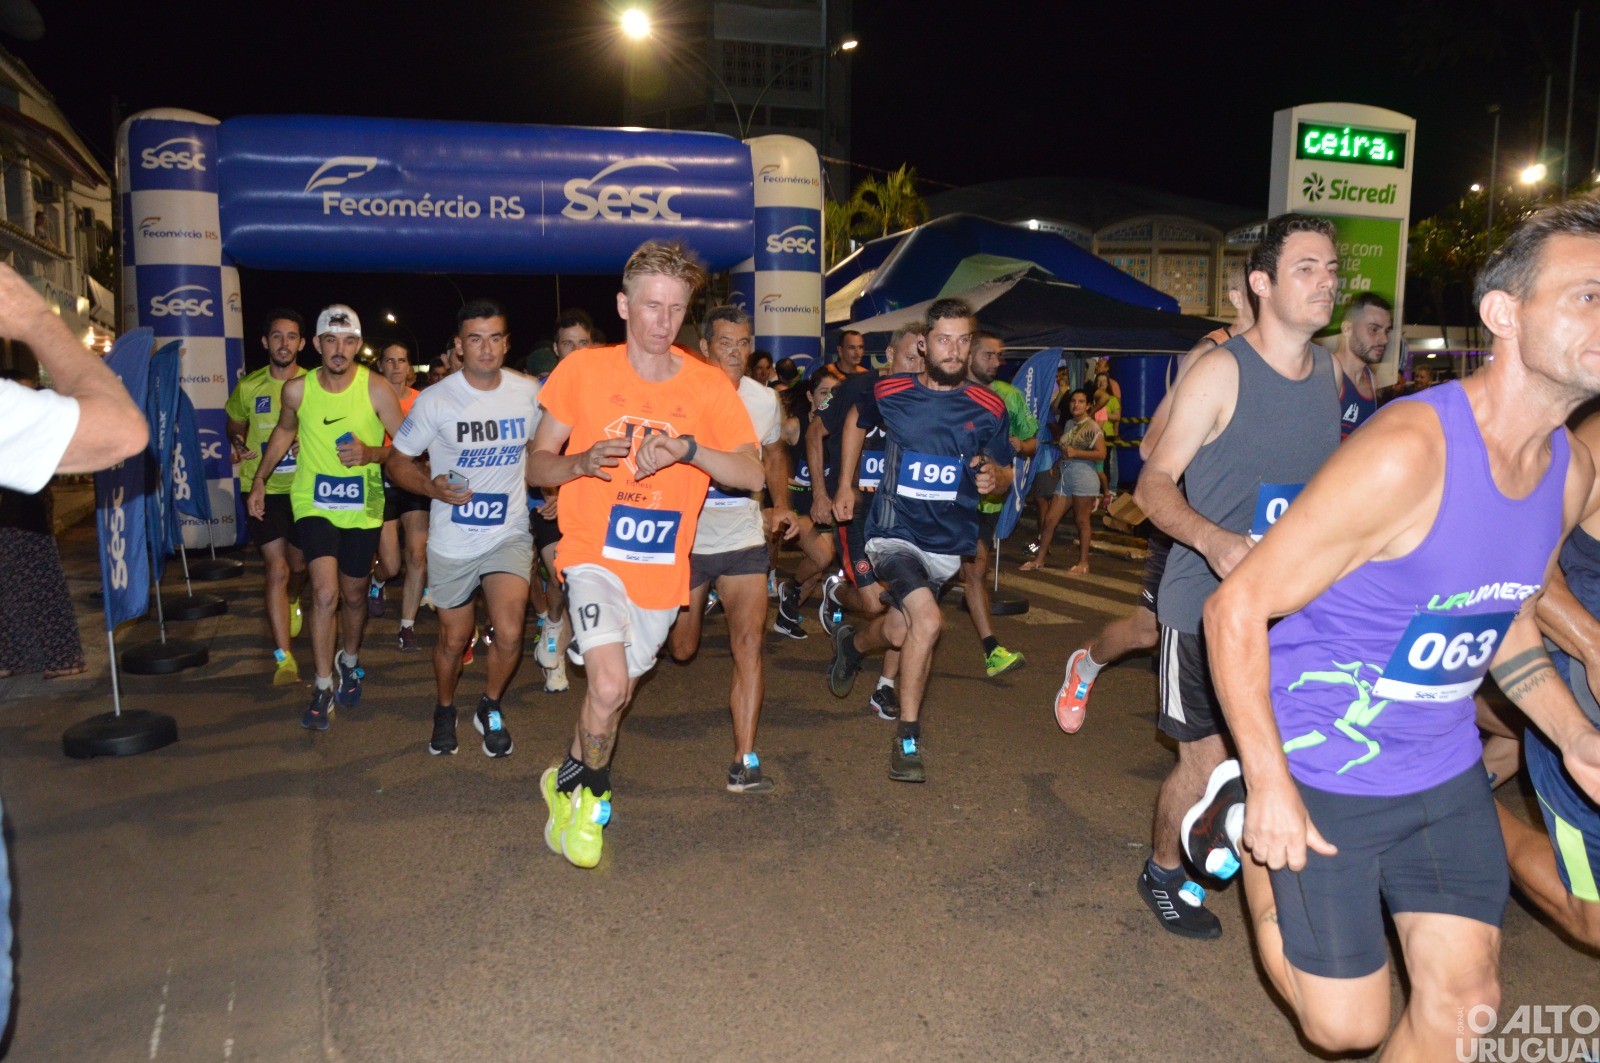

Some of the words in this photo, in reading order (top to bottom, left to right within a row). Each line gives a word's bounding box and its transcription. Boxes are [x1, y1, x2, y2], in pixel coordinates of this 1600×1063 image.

[141, 146, 207, 171] Sesc
[763, 174, 811, 185] Fecomércio
[561, 175, 682, 223] Sesc
[1329, 178, 1397, 204] Sicredi
[323, 190, 482, 220] Fecomércio
[490, 195, 526, 220] RS
[143, 228, 203, 240] Fecomércio
[204, 230, 219, 241] RS
[765, 232, 816, 255] Sesc
[1351, 243, 1383, 258] com
[1350, 273, 1371, 291] da
[151, 293, 214, 317] Sesc
[764, 303, 812, 314] Fecomércio
[212, 374, 226, 383] RS
[456, 418, 525, 443] PROFIT
[460, 448, 497, 458] BUILD
[908, 461, 957, 485] 196
[318, 482, 360, 498] 046
[626, 479, 653, 490] Fitness
[616, 491, 648, 503] BIKE+
[458, 500, 504, 519] 002
[615, 516, 675, 544] 007
[577, 603, 600, 631] 19
[1407, 628, 1498, 671] 063
